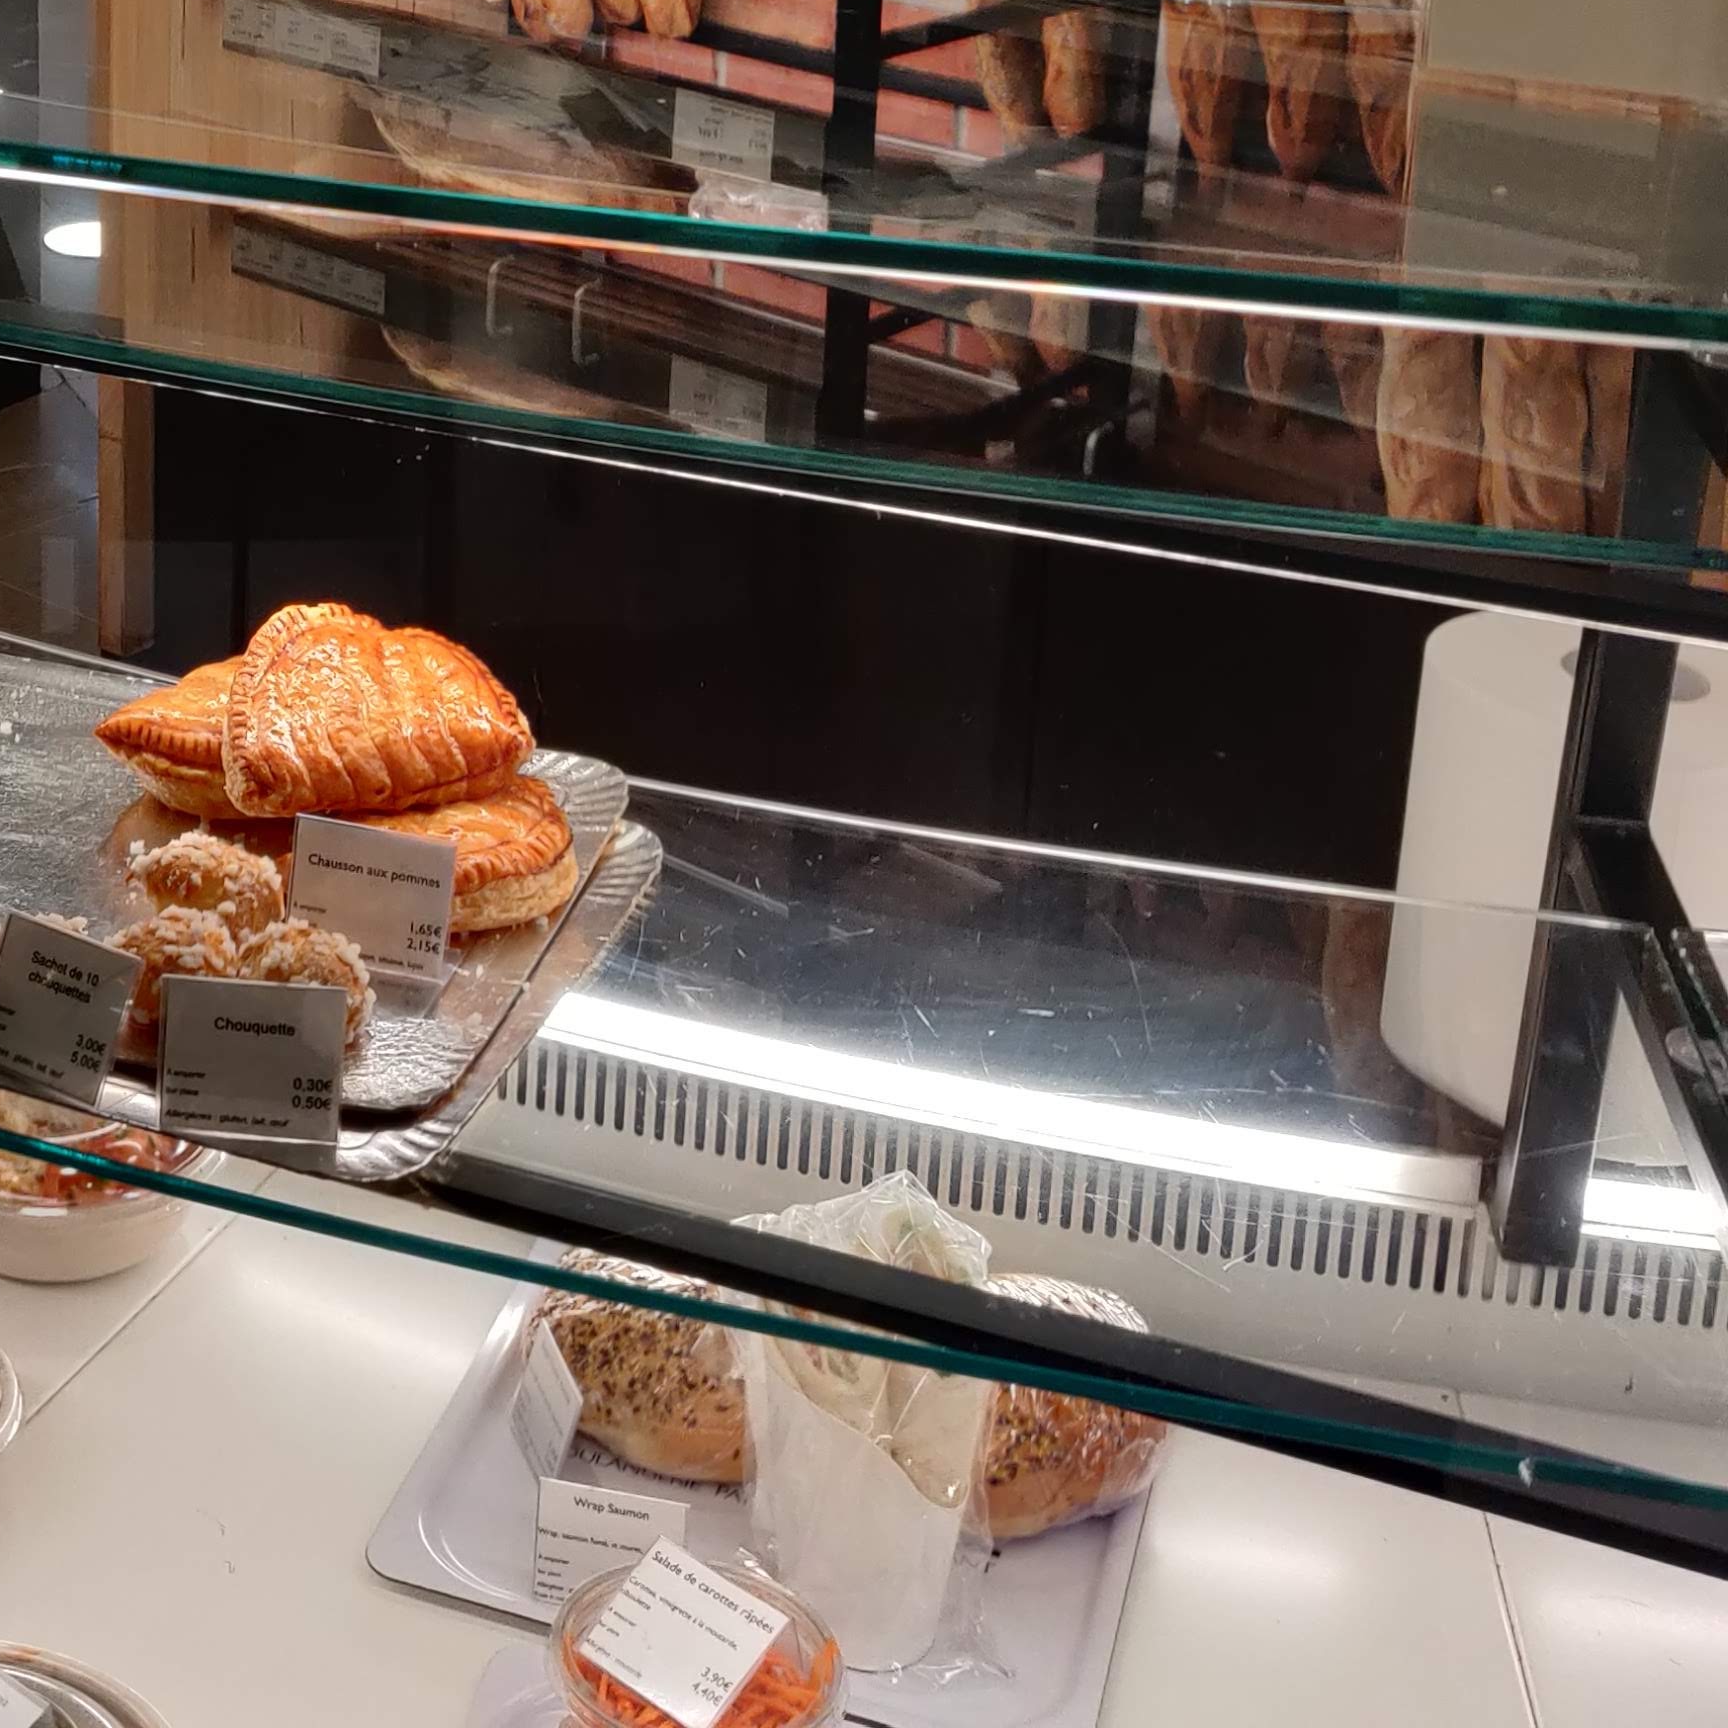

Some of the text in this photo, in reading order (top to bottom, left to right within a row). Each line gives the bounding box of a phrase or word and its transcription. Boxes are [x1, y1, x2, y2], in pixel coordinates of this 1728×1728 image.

[308, 853, 441, 890] Chausson aux pommes
[69, 966, 83, 982] de
[86, 972, 100, 988] 10
[213, 1016, 296, 1038] Chouquette
[574, 1495, 650, 1521] Wrap Saumon
[651, 1550, 776, 1636] Salade de carottes râpées
